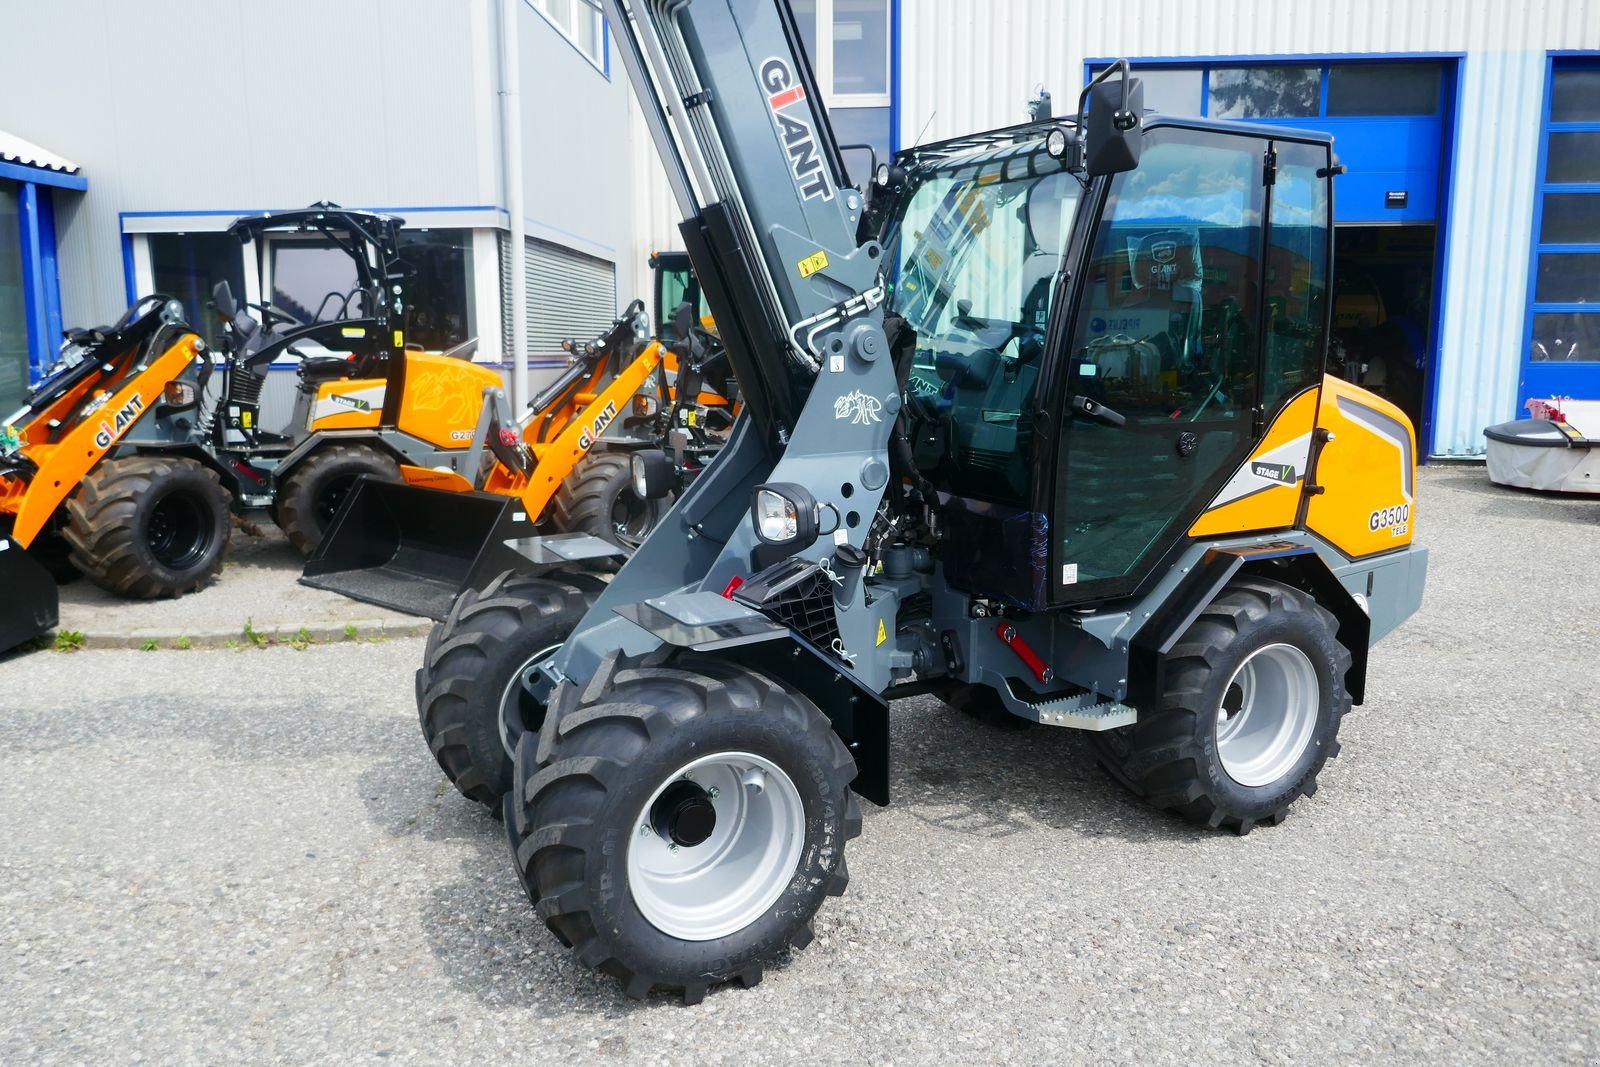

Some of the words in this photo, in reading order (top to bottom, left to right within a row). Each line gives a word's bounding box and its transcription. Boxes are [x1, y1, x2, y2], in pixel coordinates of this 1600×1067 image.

[759, 57, 833, 201] GIANT
[95, 393, 144, 449] GIANT
[579, 400, 617, 450] GIANT
[1256, 466, 1279, 479] STAGE
[1369, 503, 1409, 531] G3500
[1392, 525, 1406, 536] TELE
